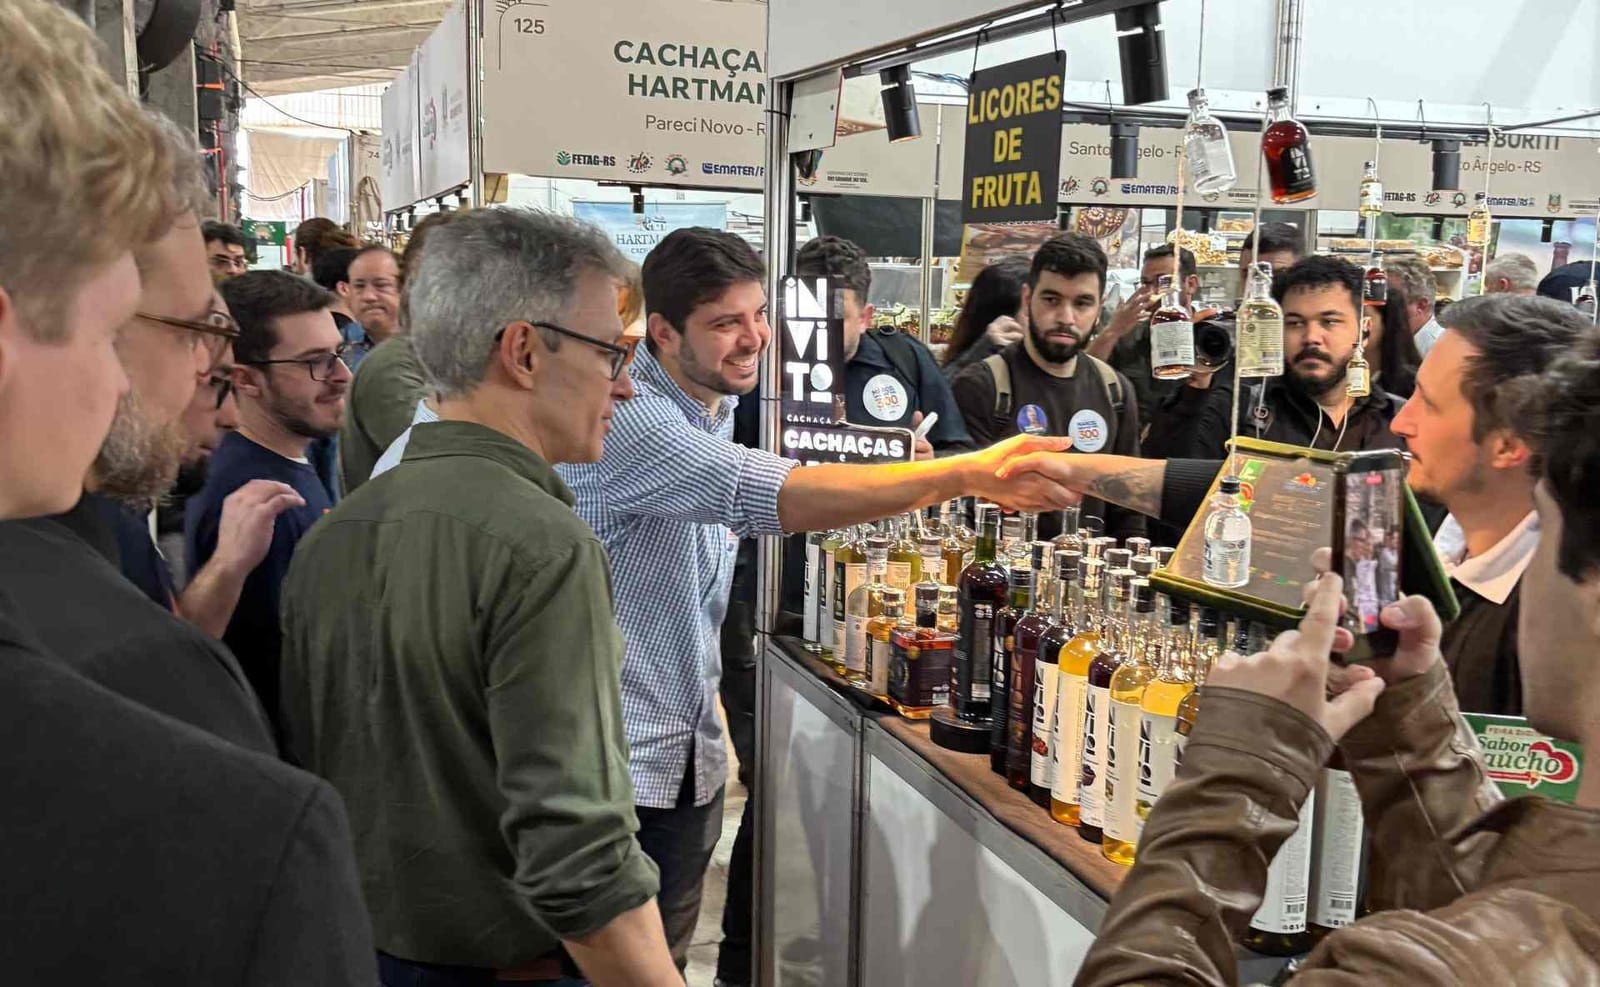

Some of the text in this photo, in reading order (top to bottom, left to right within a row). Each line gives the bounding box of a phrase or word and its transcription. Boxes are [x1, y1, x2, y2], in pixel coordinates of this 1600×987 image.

[514, 18, 545, 34] 125
[613, 40, 766, 78] CACHAÇA
[968, 75, 1061, 125] LICORES
[646, 115, 697, 132] Pareci
[701, 119, 744, 135] Novo
[757, 122, 765, 136] R
[994, 127, 1023, 163] DE
[1069, 141, 1112, 156] Santo
[1137, 145, 1164, 160] gelo
[572, 153, 616, 167] FETAG-RS
[1524, 161, 1541, 173] RS
[972, 171, 1042, 209] FRUTA
[1384, 192, 1416, 202] FETAG-RS
[786, 413, 832, 425] CACHAÇA
[784, 429, 904, 458] CACHAÇAS
[1478, 735, 1530, 752] Sabor
[1484, 750, 1559, 774] aúcho
